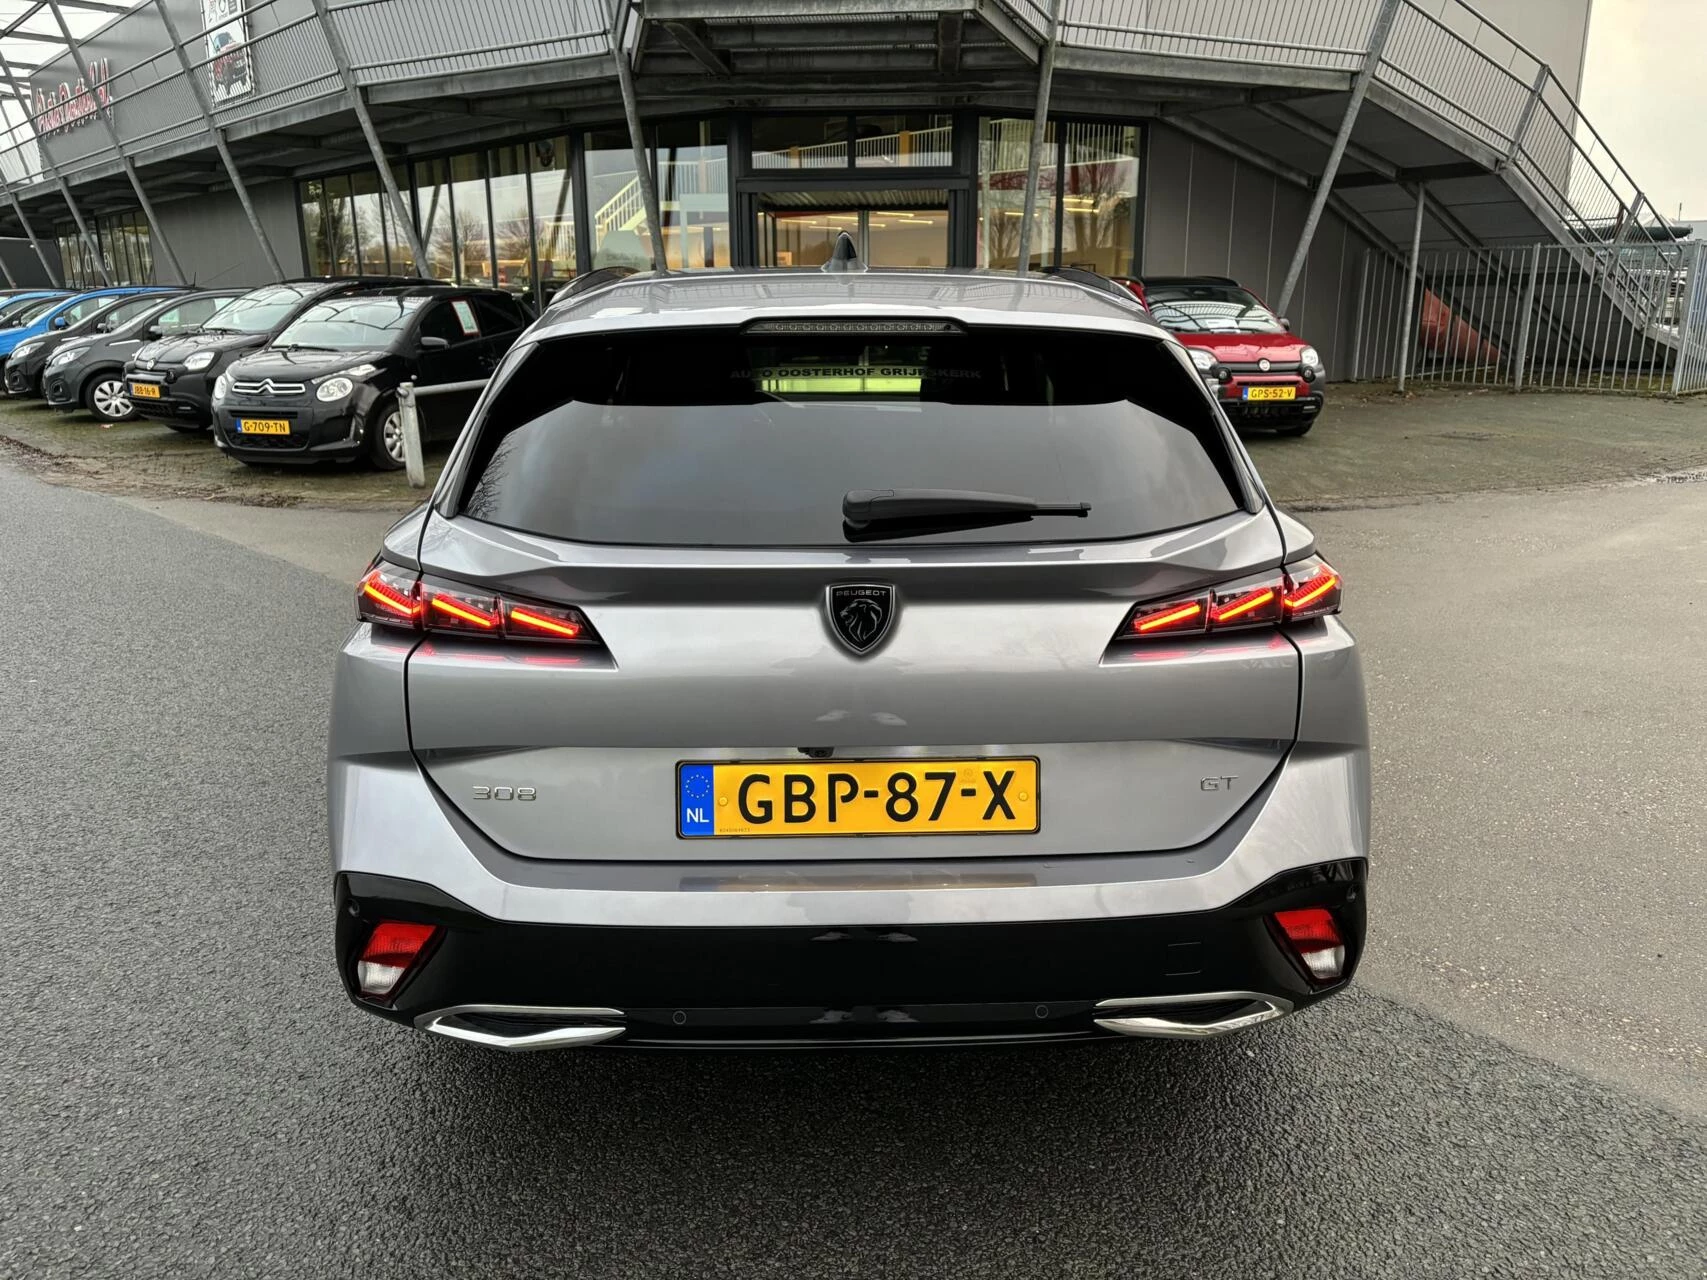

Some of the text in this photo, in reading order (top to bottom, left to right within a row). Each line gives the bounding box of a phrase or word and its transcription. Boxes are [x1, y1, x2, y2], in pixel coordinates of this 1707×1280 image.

[778, 367, 876, 378] OOSTERHOF
[1251, 388, 1293, 398] GPS-52-V
[243, 421, 286, 432] G-709-TN
[836, 589, 887, 597] PEUGEOT
[1200, 775, 1240, 791] GT
[472, 786, 537, 801] 308
[737, 770, 1017, 824] GBP-87-X
[686, 807, 710, 823] NL
